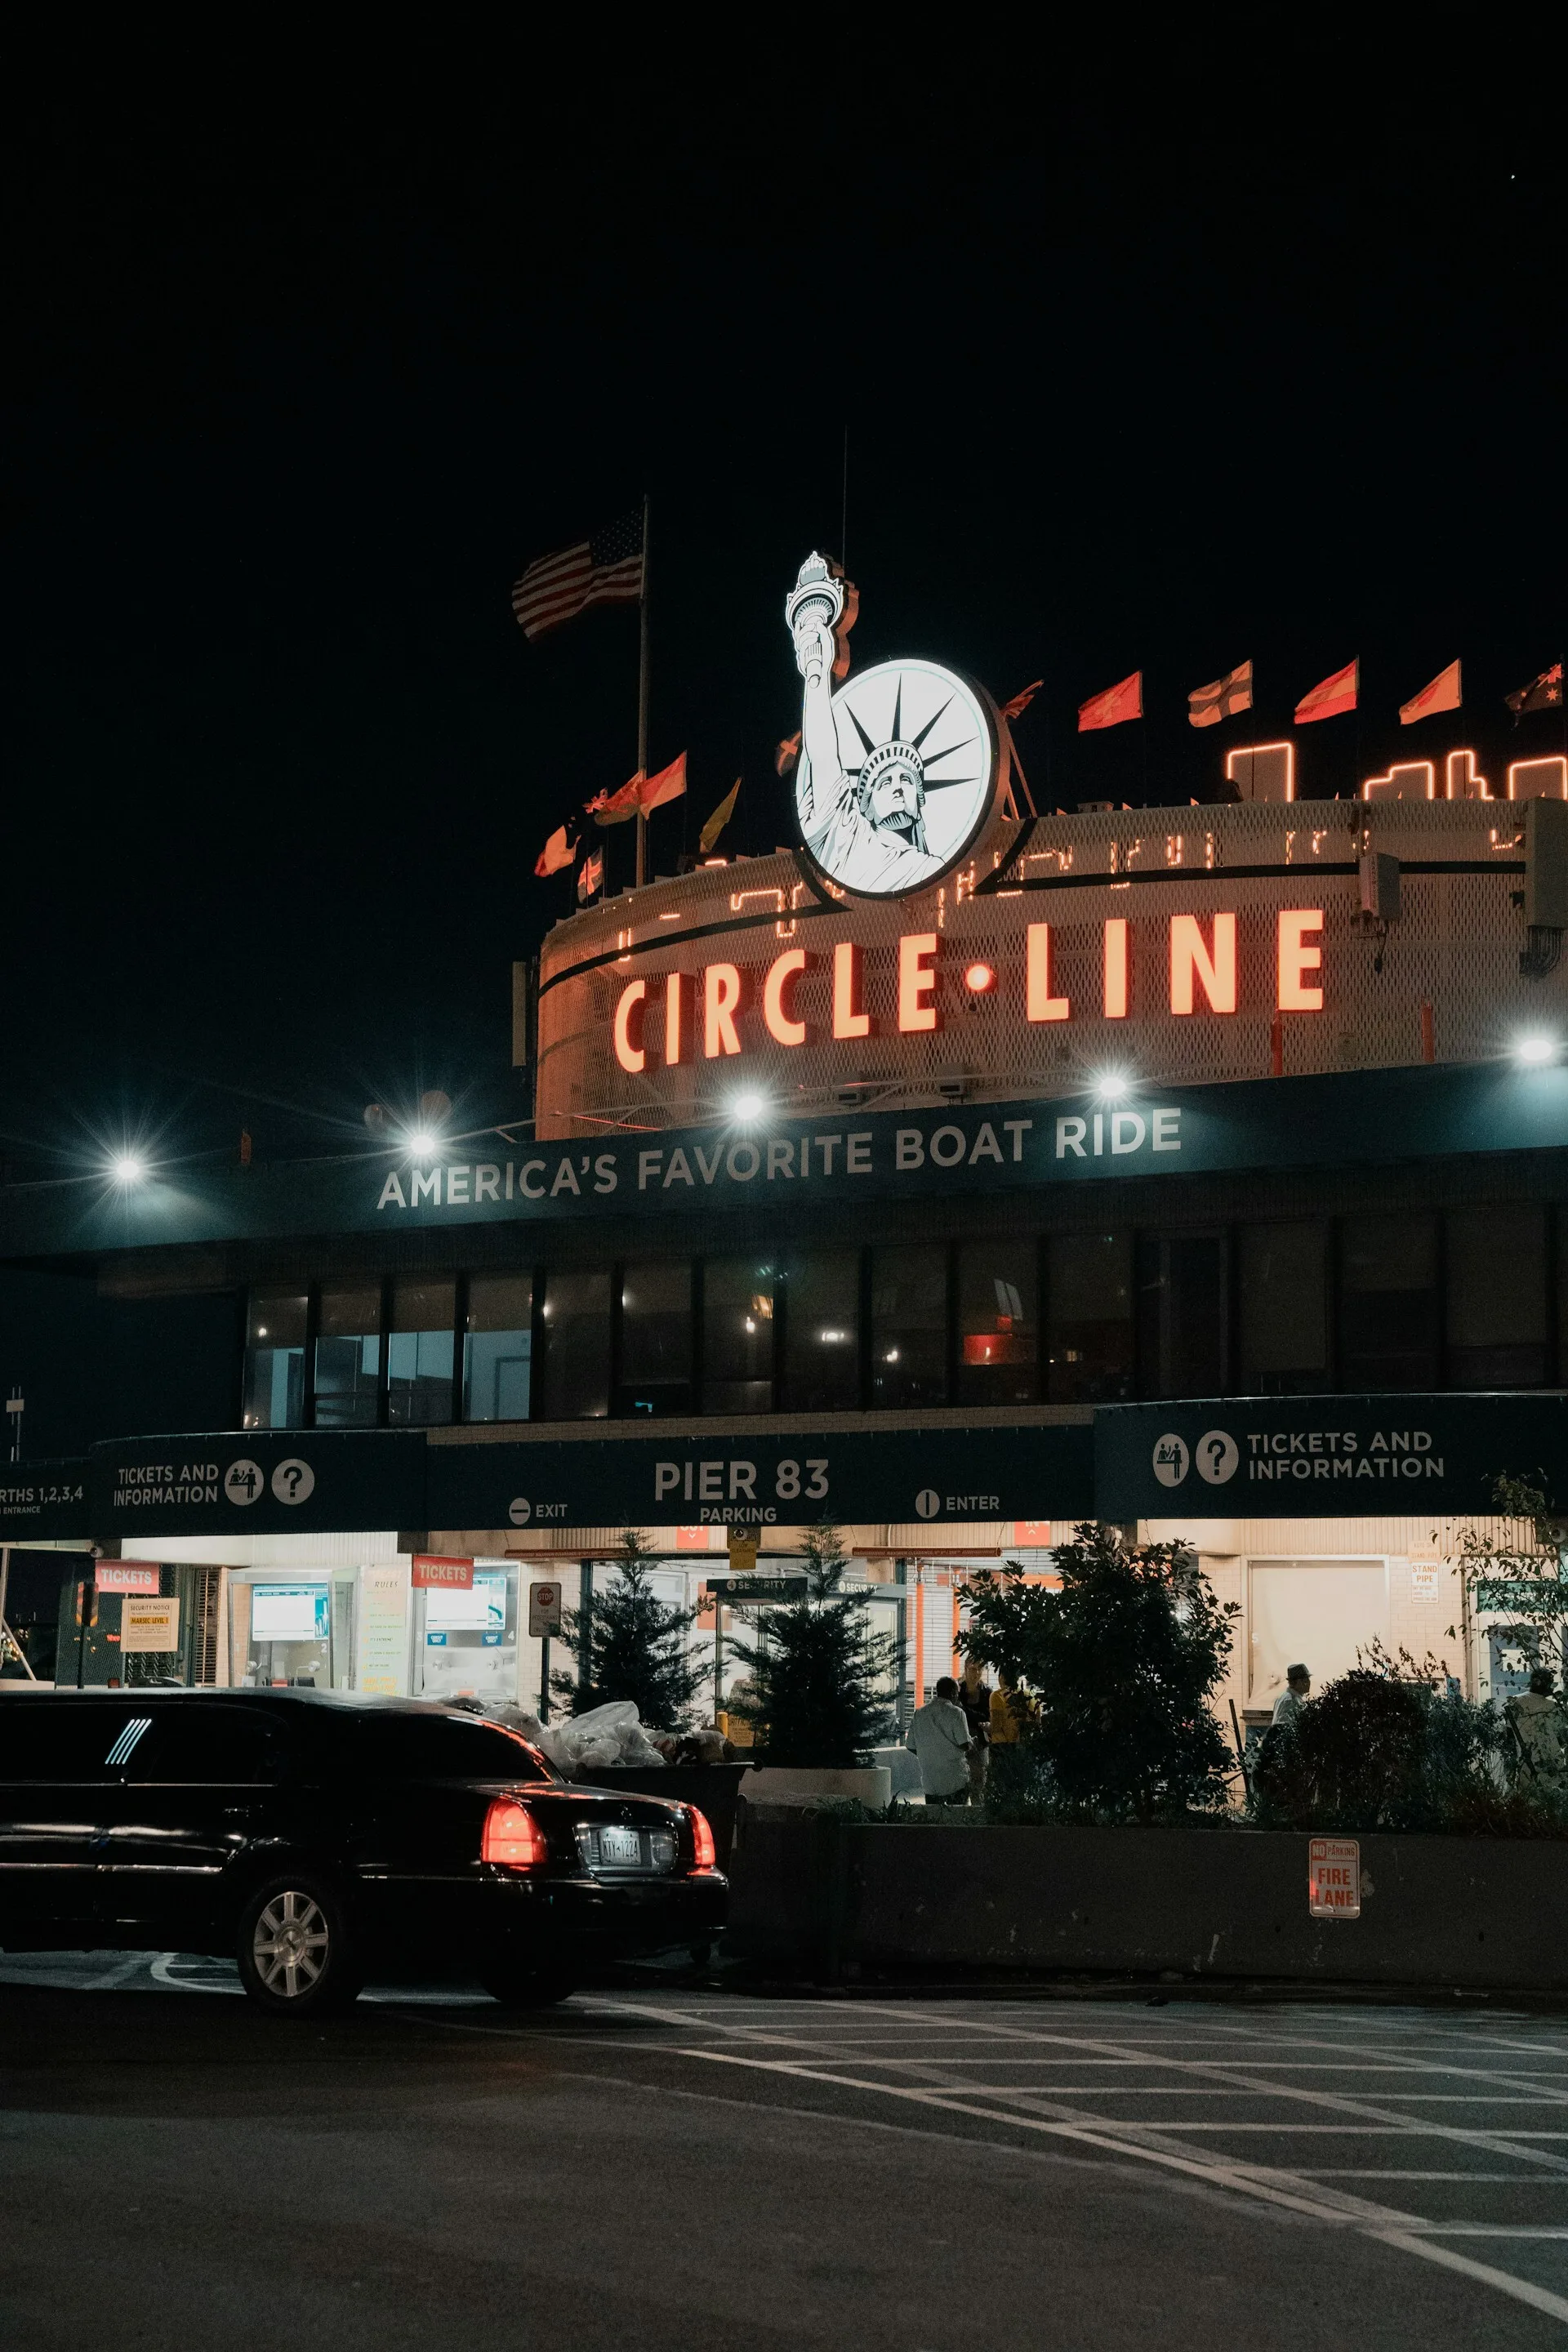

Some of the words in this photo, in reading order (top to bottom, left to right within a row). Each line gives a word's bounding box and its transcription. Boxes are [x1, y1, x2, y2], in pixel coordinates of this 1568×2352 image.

[614, 933, 937, 1073] CIRCLE
[1027, 909, 1323, 1022] LINE
[376, 1154, 618, 1209] AMERICA'S
[638, 1132, 873, 1190] FAVORITE
[895, 1119, 1033, 1170] BOAT
[1055, 1107, 1181, 1159] RIDE
[1247, 1432, 1358, 1454] TICKETS
[1370, 1431, 1432, 1452] AND
[118, 1465, 173, 1485] TICKETS
[179, 1463, 219, 1482] AND
[1249, 1457, 1445, 1481] INFORMATION
[655, 1460, 757, 1501] PIER
[776, 1459, 830, 1499] 83
[38, 1485, 83, 1503] 1,2,3,4
[114, 1486, 218, 1507] INFORMATION
[3, 1505, 41, 1514] ENTRANCE
[536, 1503, 568, 1517] EXIT
[946, 1495, 1000, 1511] ENTER
[700, 1507, 777, 1522] PARKING
[100, 1569, 152, 1585] TICKETS
[419, 1564, 467, 1581] TICKETS
[1412, 1565, 1437, 1573] STAND
[375, 1580, 399, 1588] RULES
[1416, 1575, 1433, 1583] PIPE
[537, 1592, 554, 1601] STOP
[507, 1630, 515, 1641] 4
[321, 1642, 327, 1653] 2
[1312, 1844, 1325, 1857] NO
[1328, 1846, 1355, 1856] PARKING
[1317, 1868, 1351, 1886] FIRE
[1314, 1888, 1355, 1907] LANE
